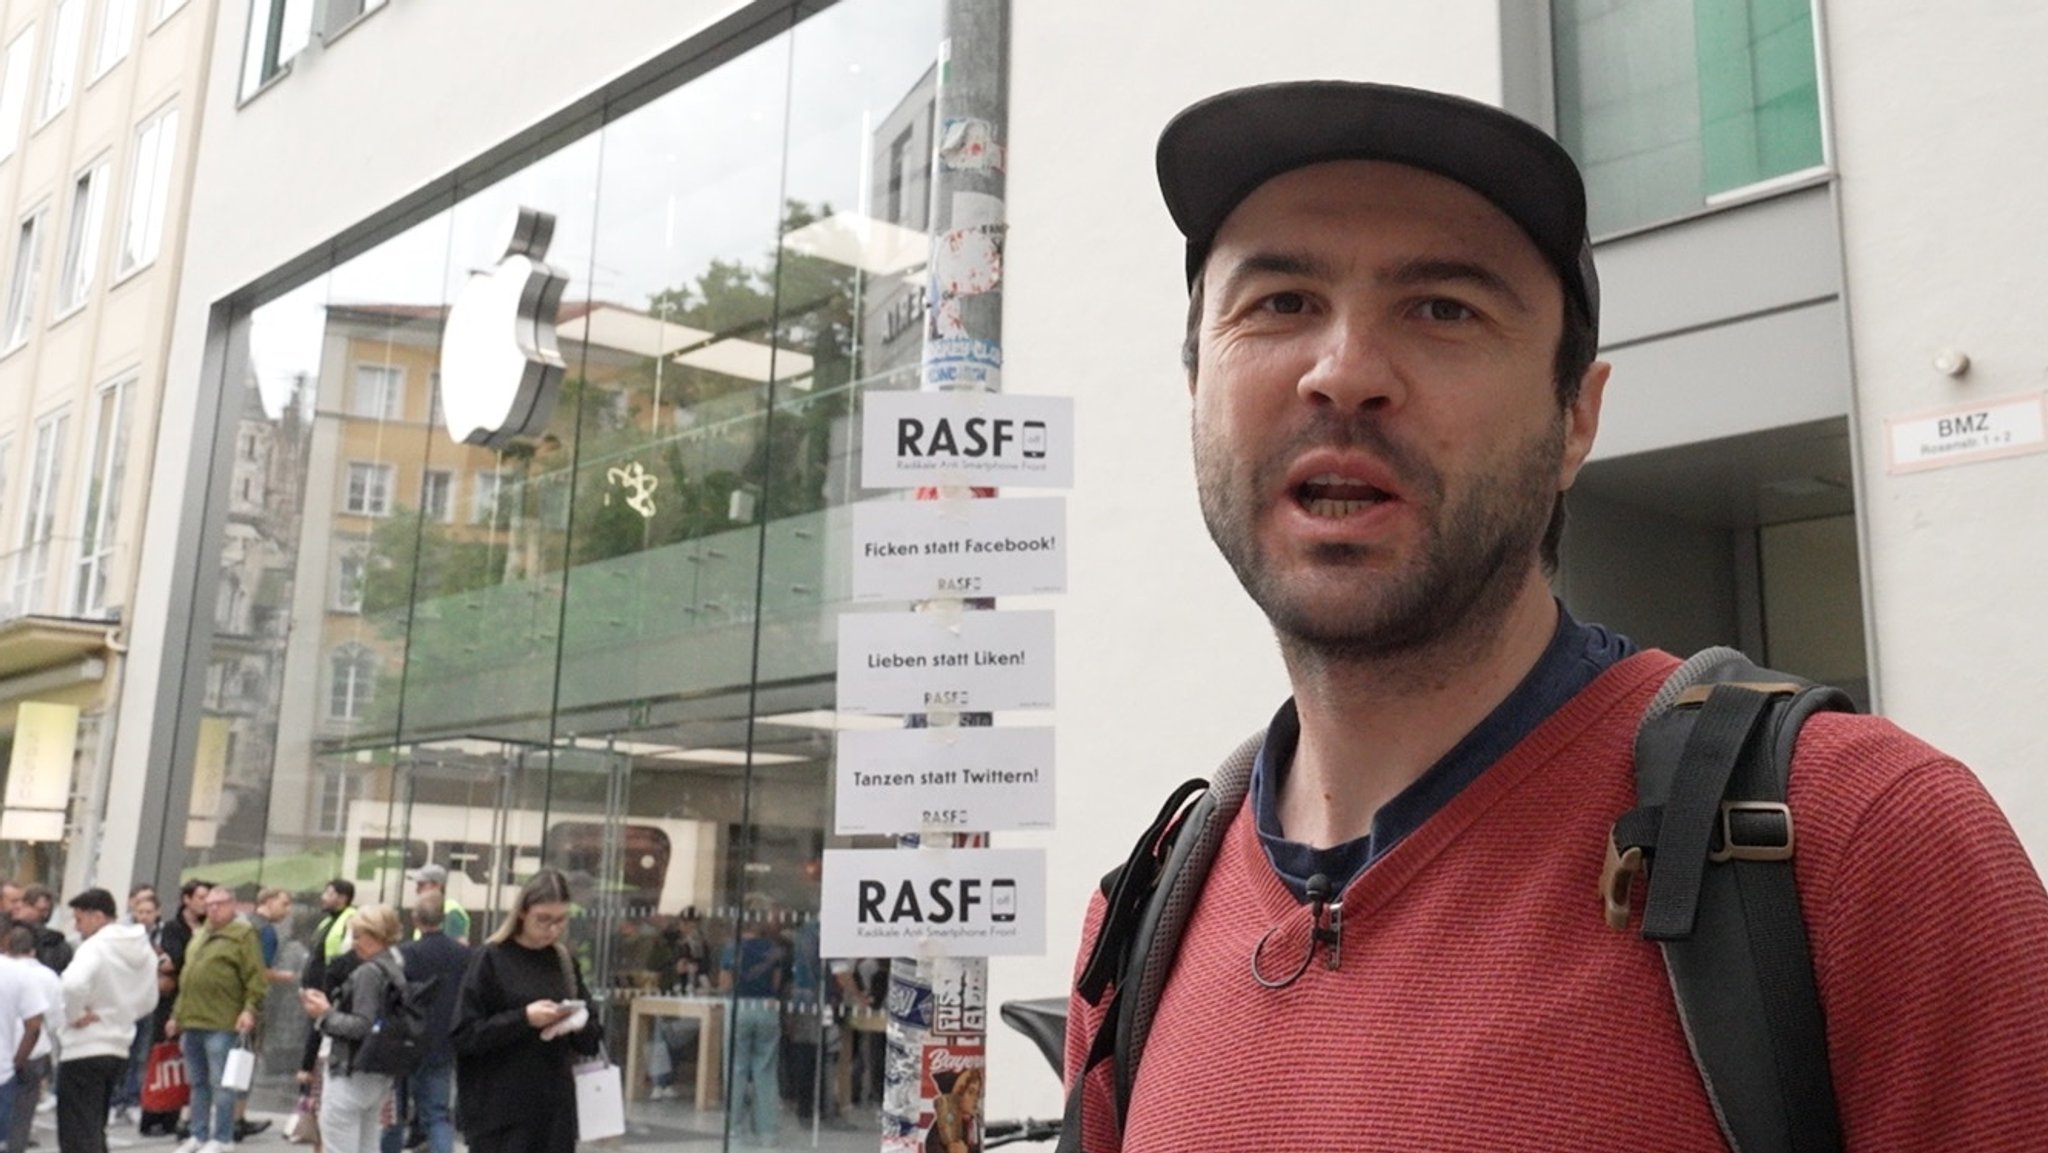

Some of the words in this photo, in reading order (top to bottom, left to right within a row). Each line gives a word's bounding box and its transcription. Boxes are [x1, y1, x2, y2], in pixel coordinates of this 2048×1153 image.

[1938, 412, 1990, 437] BMZ
[897, 417, 1014, 458] RASF
[940, 460, 959, 470] Anti
[865, 542, 919, 557] Ficken
[925, 540, 960, 555] statt
[965, 536, 1056, 554] Facebook!
[938, 577, 972, 591] RASF
[868, 653, 927, 668] Lieben
[933, 652, 969, 667] statt
[974, 651, 1026, 666] Liken!
[924, 691, 960, 704] RASF
[854, 771, 915, 786] Tanzen
[921, 770, 957, 785] statt
[963, 768, 1039, 784] Twittern!
[922, 810, 957, 824] RASF
[858, 878, 982, 924] RASF
[857, 927, 900, 937] Radikale
[903, 927, 924, 937] Anti
[927, 927, 987, 938] Smartphone
[990, 926, 1017, 937] Front
